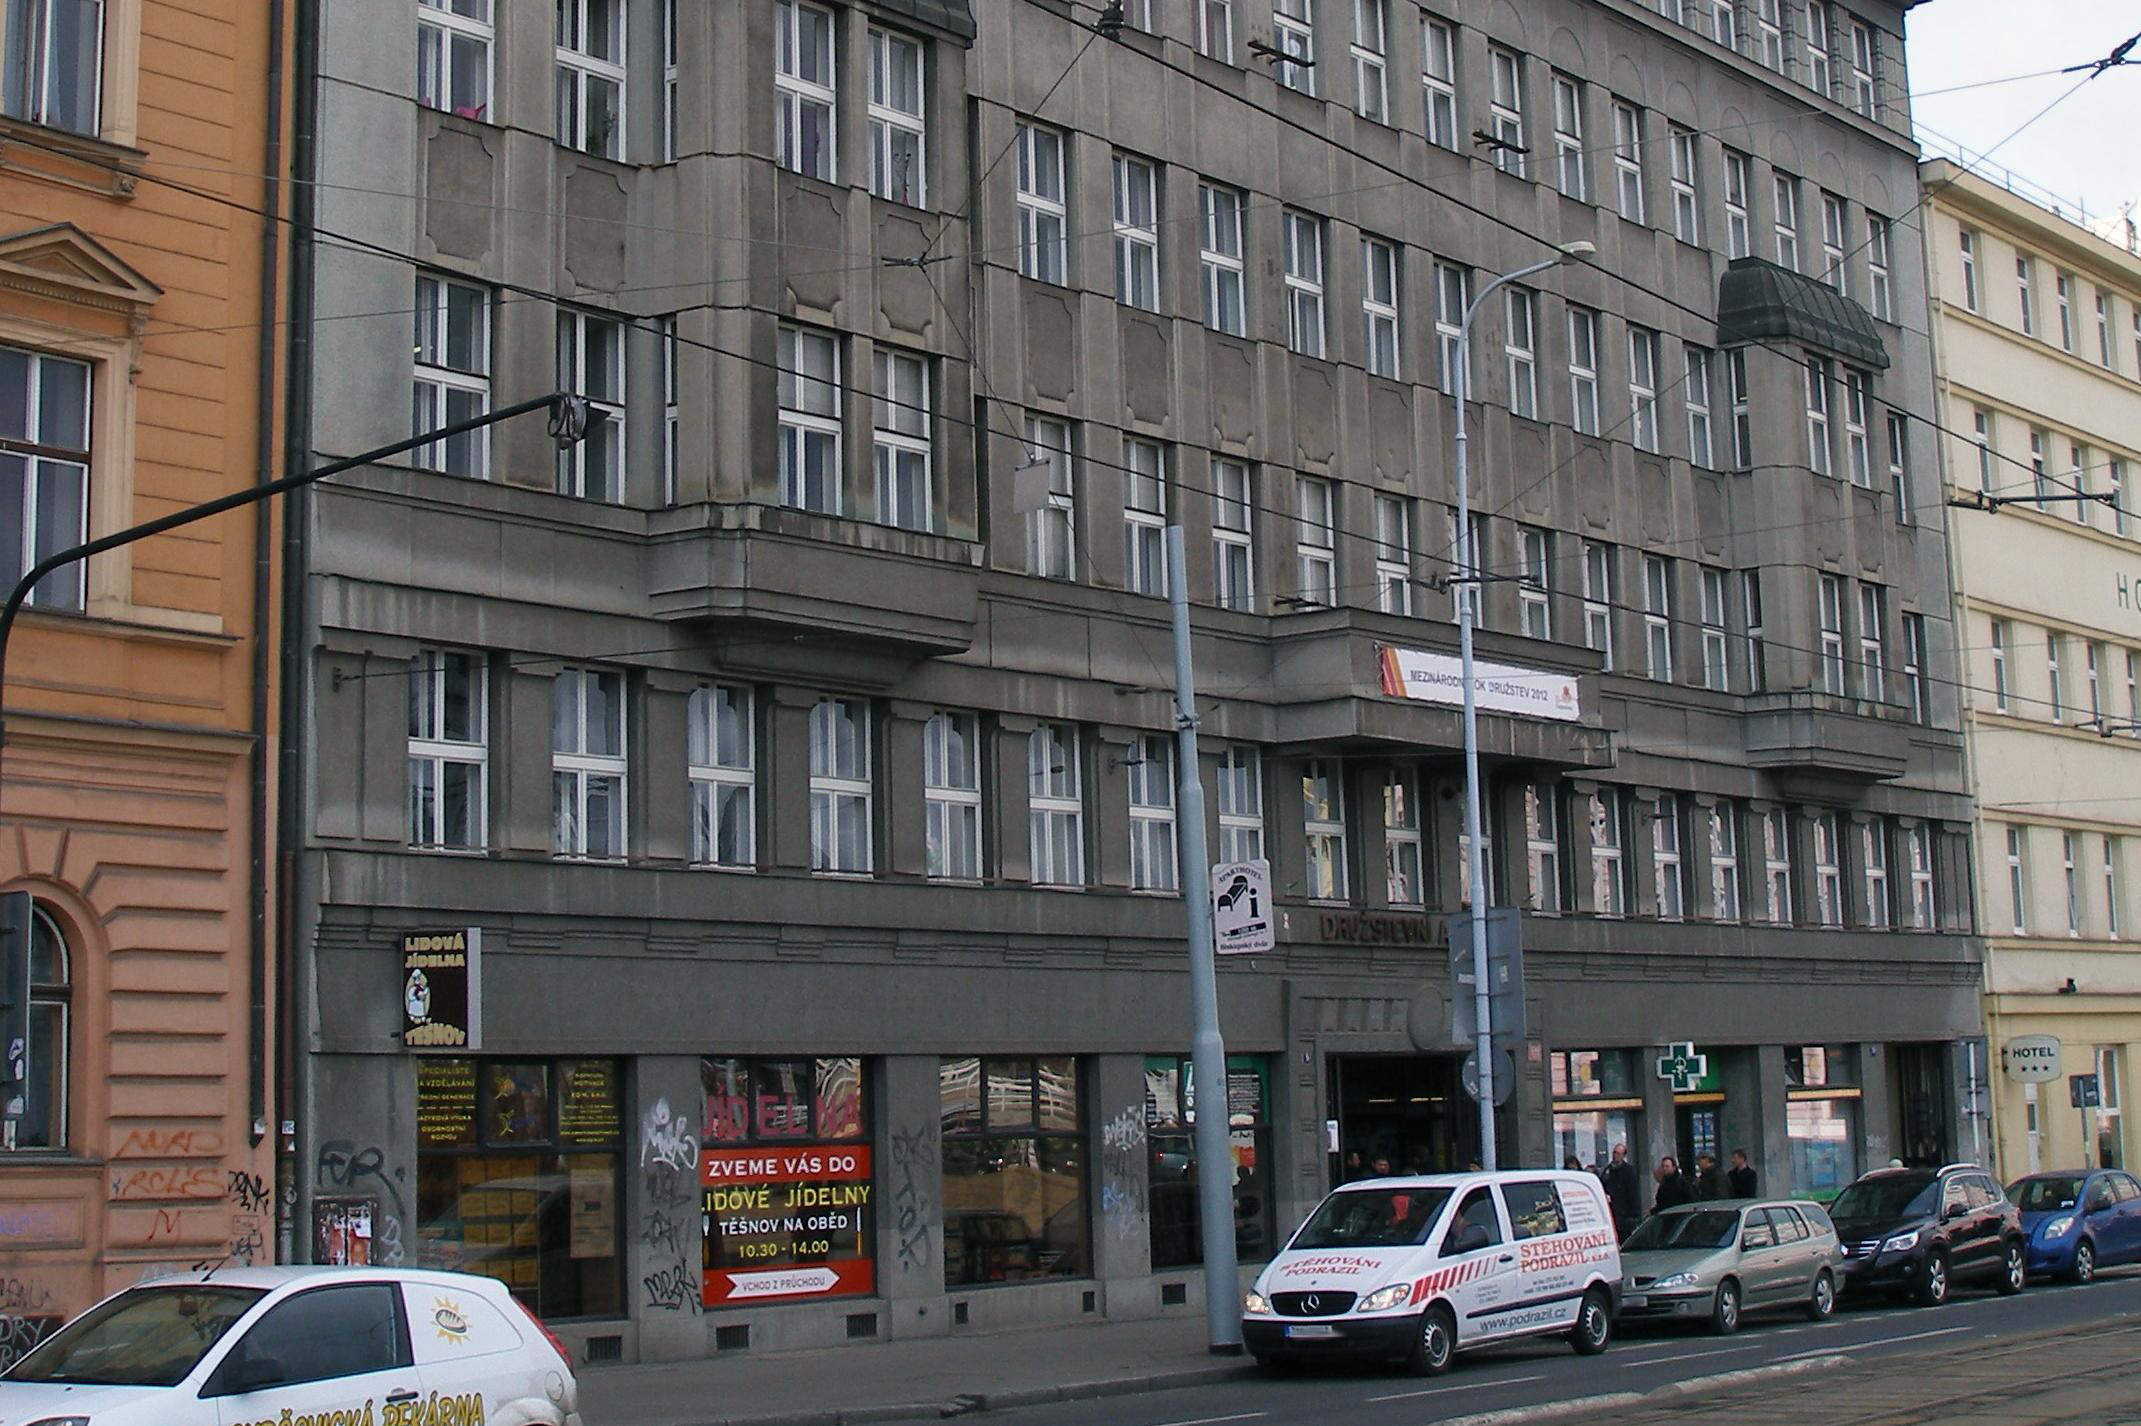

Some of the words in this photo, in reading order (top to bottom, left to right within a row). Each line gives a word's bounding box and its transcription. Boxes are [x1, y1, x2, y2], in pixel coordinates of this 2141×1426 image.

[1410, 669, 1465, 690] MEZINÁRODN
[1488, 681, 1531, 698] DRUŽSTEV
[1531, 687, 1549, 701] 2012
[404, 932, 465, 951] LIDOVÁ
[404, 952, 465, 968] JÍDELNA
[404, 1018, 466, 1046] TĚŠNOV
[2013, 1047, 2054, 1057] HOTEL
[708, 1158, 778, 1178] ZVEME
[784, 1152, 822, 1175] VÁS
[829, 1156, 855, 1173] DO
[701, 1184, 769, 1213] IDOVÉ
[784, 1182, 870, 1208] JÍDELNY
[719, 1216, 779, 1236] TĚŠNOV
[783, 1218, 803, 1233] NA
[807, 1210, 848, 1230] OBĚD
[739, 1243, 777, 1259] 10.30
[792, 1240, 829, 1256] 14.00
[1520, 1230, 1607, 1258] STĚHOVÁNÍ
[1285, 1267, 1361, 1277] PODRAZIL
[1520, 1252, 1587, 1273] PODRAZIL
[743, 1279, 771, 1291] VCHOD
[773, 1279, 779, 1290] Z
[780, 1275, 826, 1289] PRŮCHODU
[1480, 1307, 1566, 1331] www.podrazil.cz
[383, 1390, 485, 1426] PEKÁRNA
